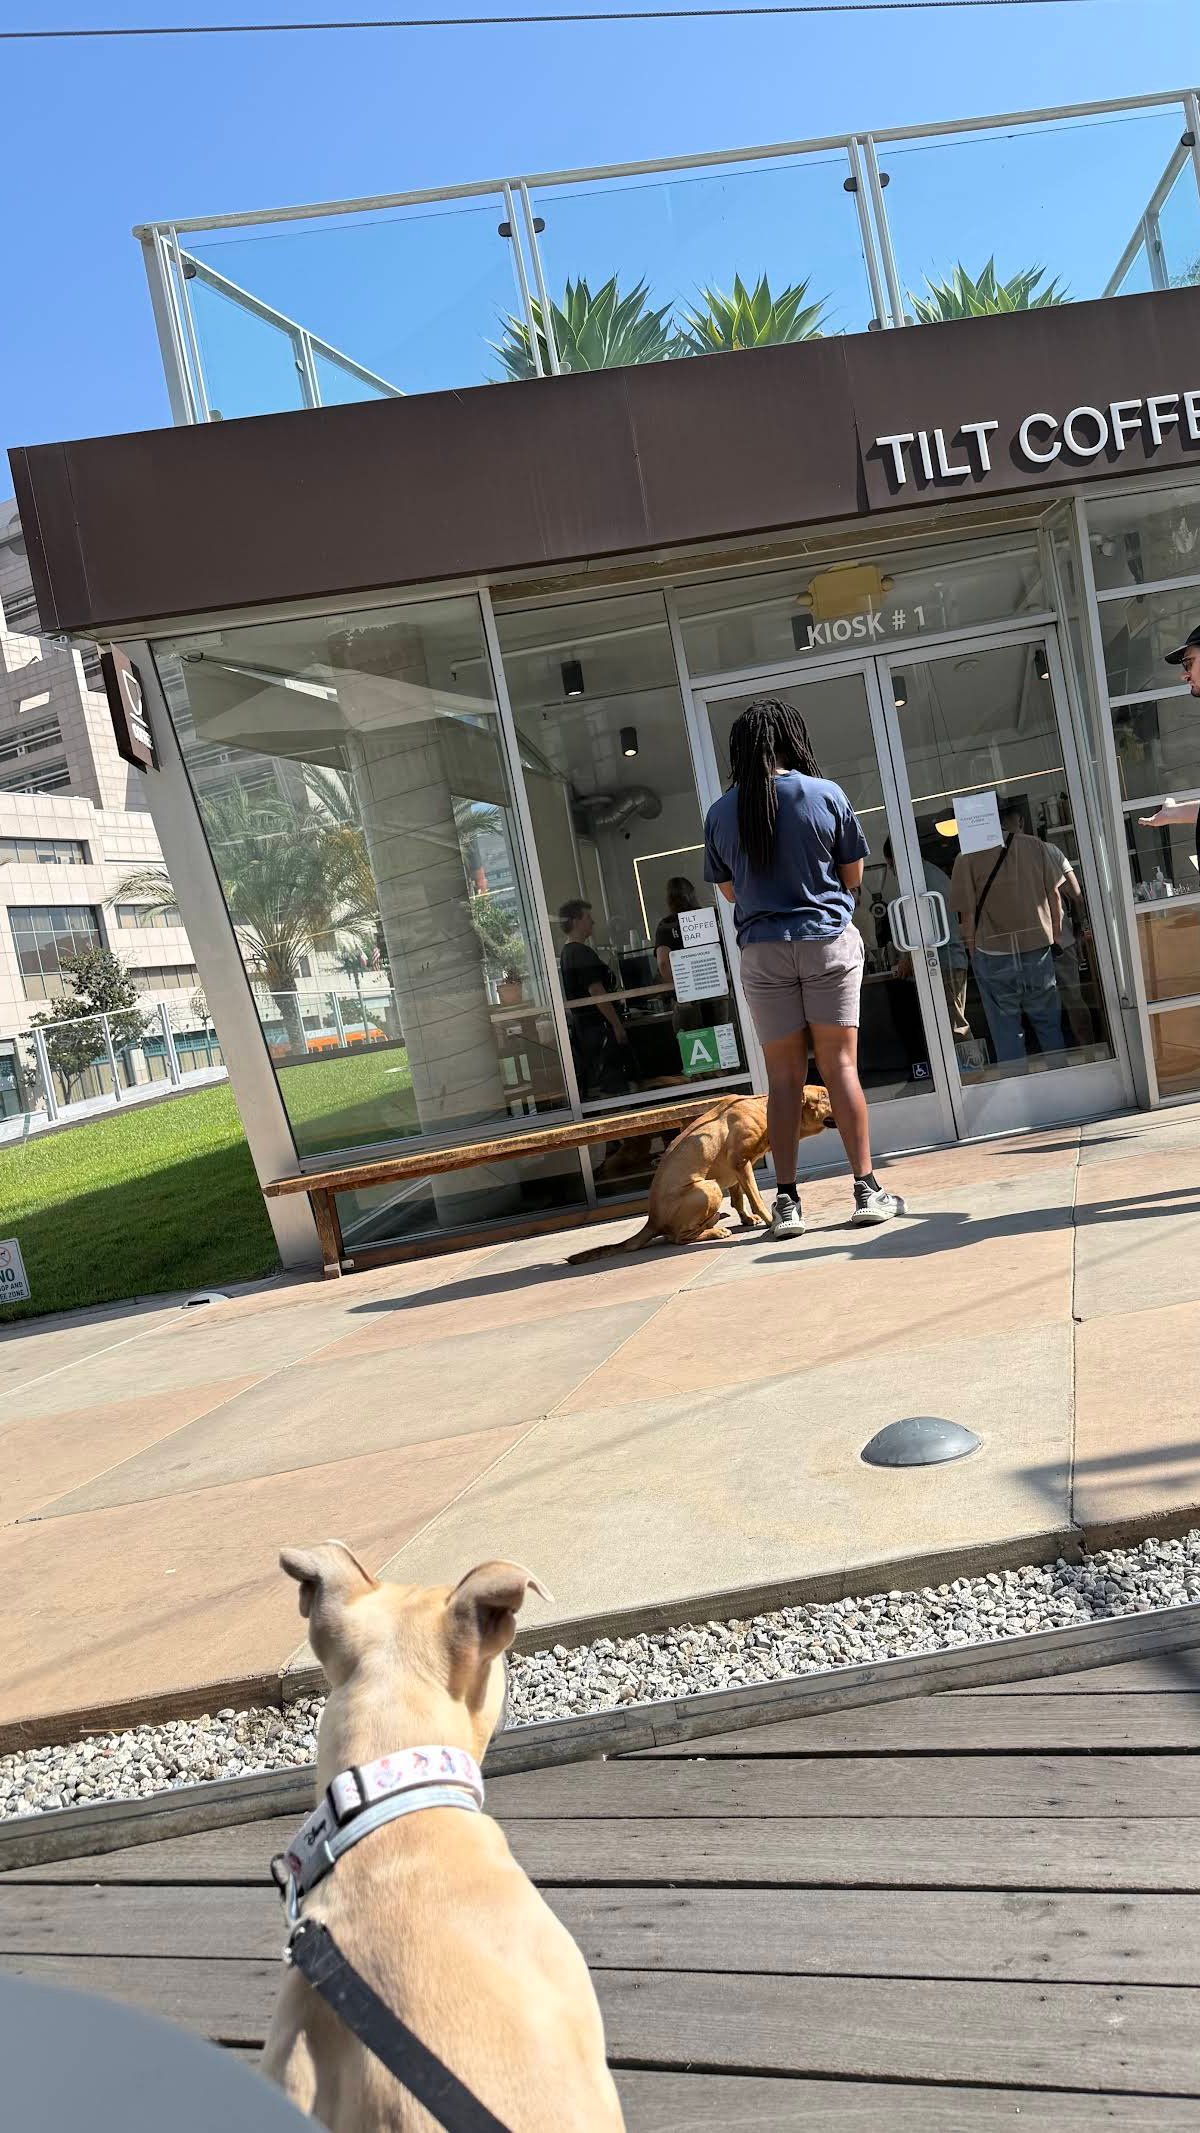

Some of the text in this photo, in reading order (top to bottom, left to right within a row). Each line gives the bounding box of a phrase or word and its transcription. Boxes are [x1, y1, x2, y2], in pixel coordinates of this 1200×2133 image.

[876, 420, 998, 484] TILT
[806, 605, 925, 646] KIOSK # 1
[681, 915, 697, 923] TILT
[682, 921, 715, 932] COFFEE
[684, 933, 701, 941] BAR
[690, 1039, 713, 1066] A
[11, 1281, 23, 1290] AND
